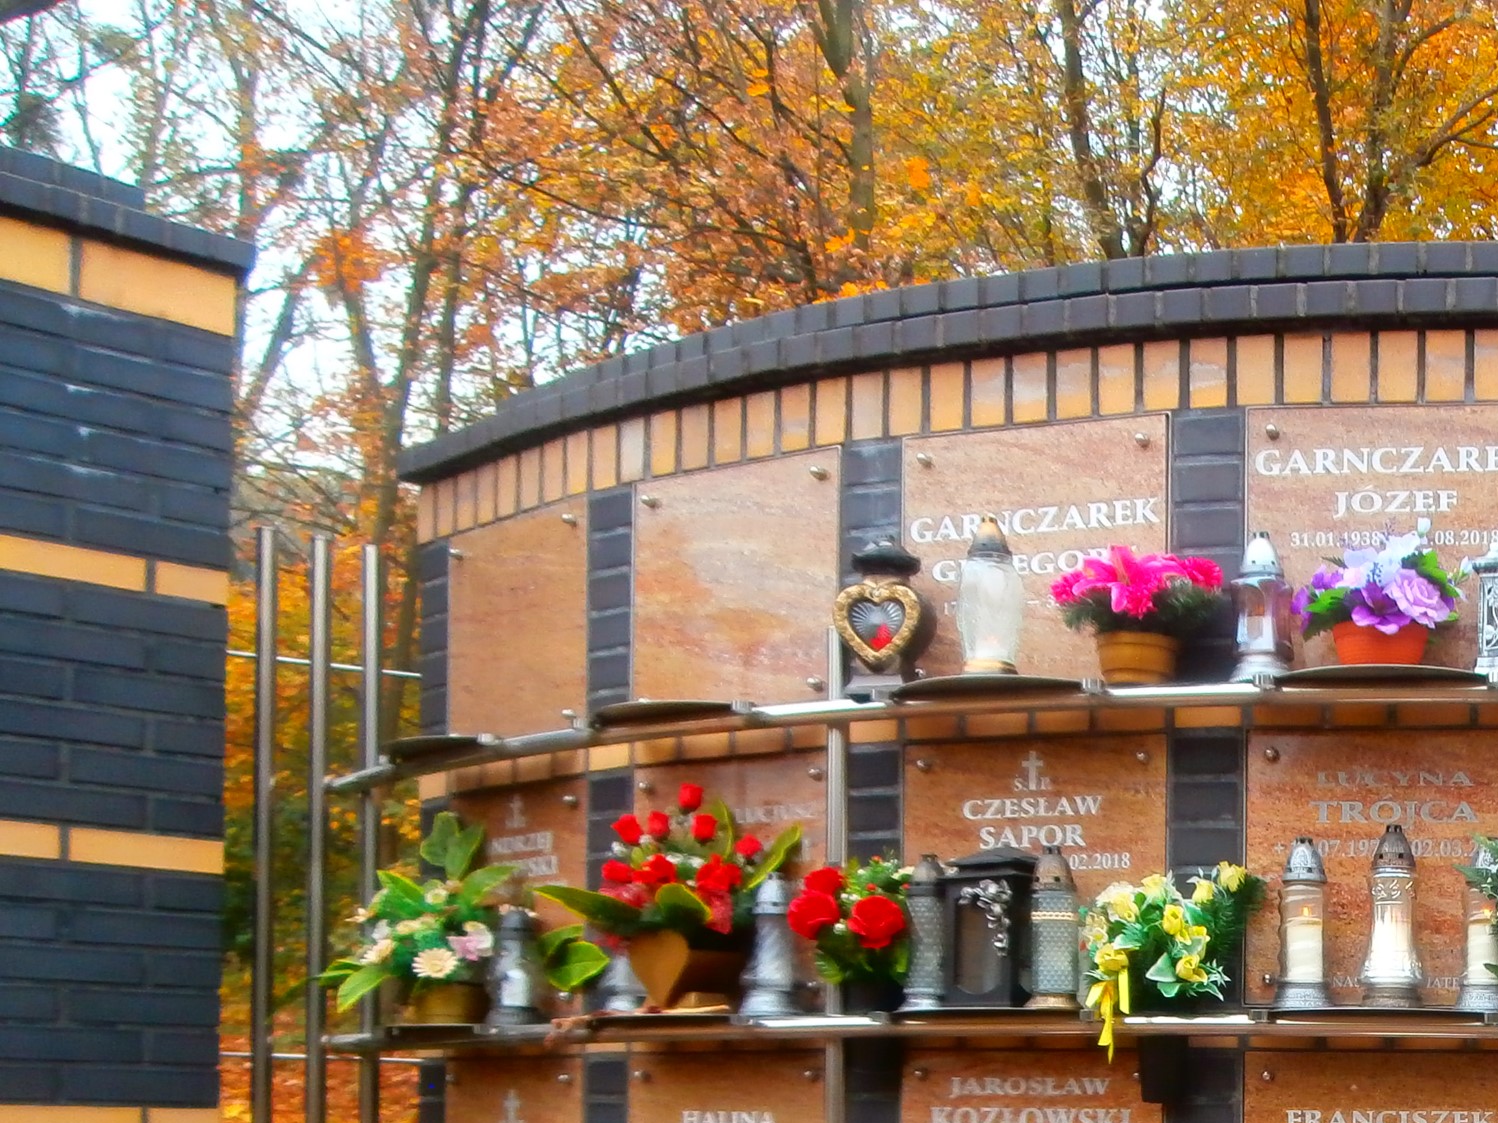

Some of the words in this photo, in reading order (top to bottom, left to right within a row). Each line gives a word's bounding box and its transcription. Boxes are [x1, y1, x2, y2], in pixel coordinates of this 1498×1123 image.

[1333, 484, 1458, 519] JÓZEF
[962, 795, 1103, 820] CZESŁAW
[1311, 794, 1479, 827] TRÓJCA
[979, 824, 1086, 850] SAPOR
[1070, 852, 1131, 871] 02.2018
[950, 1077, 1111, 1098] JAROSŁAW
